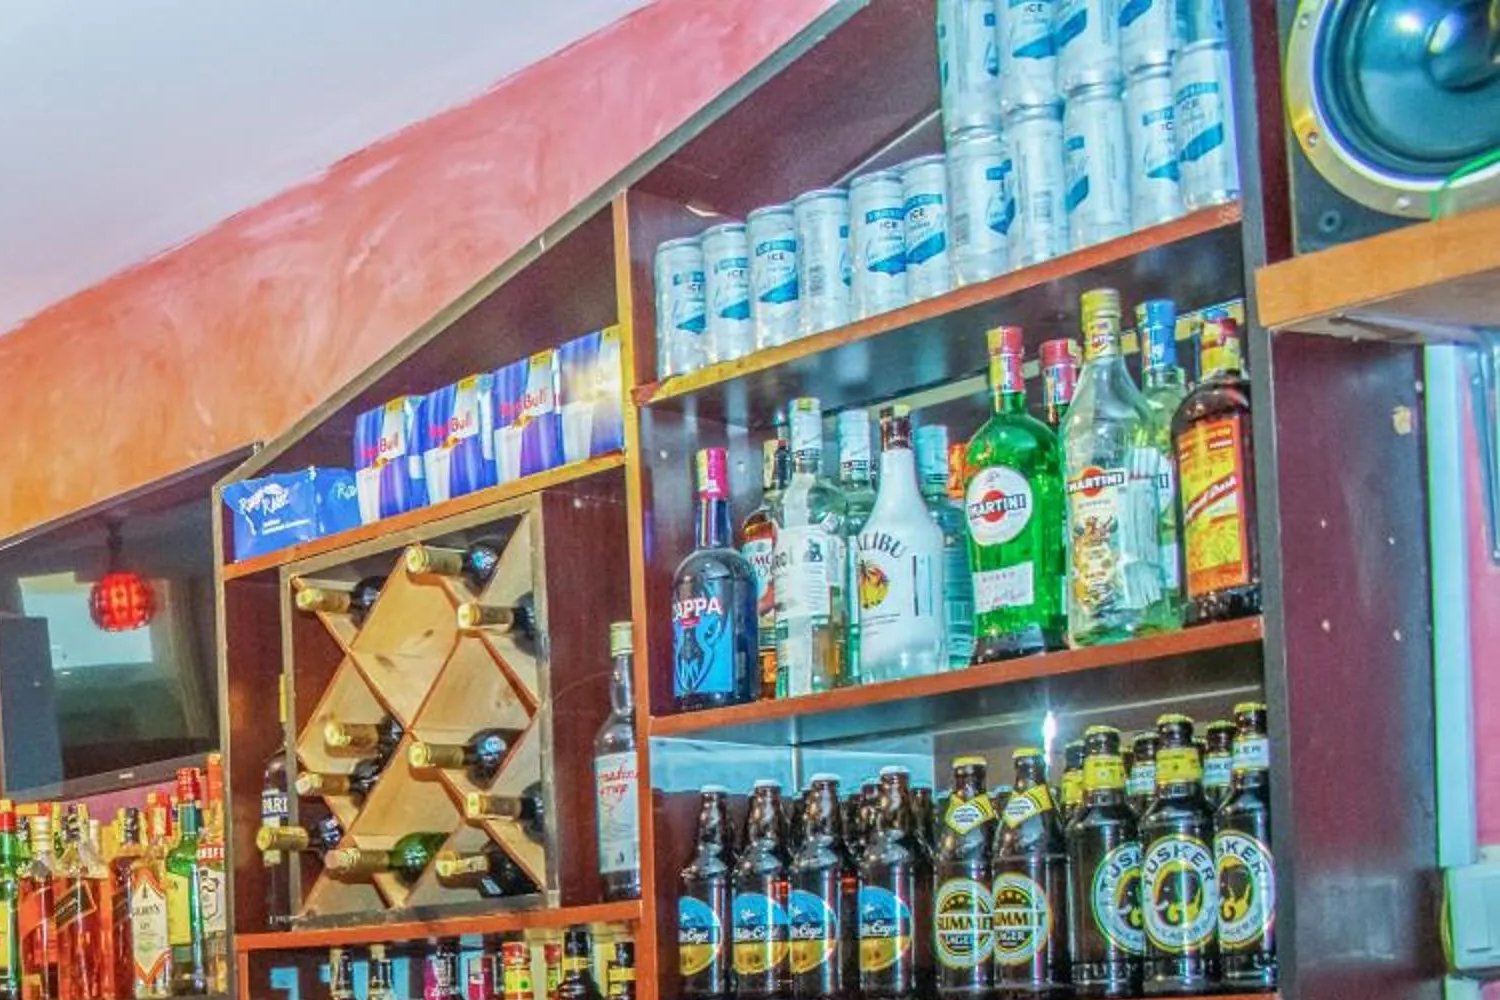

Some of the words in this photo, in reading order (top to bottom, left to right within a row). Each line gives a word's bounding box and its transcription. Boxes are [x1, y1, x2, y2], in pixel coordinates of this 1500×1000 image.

[858, 532, 908, 559] LIBU
[672, 597, 723, 620] APPA
[1145, 844, 1215, 886] TUSKER
